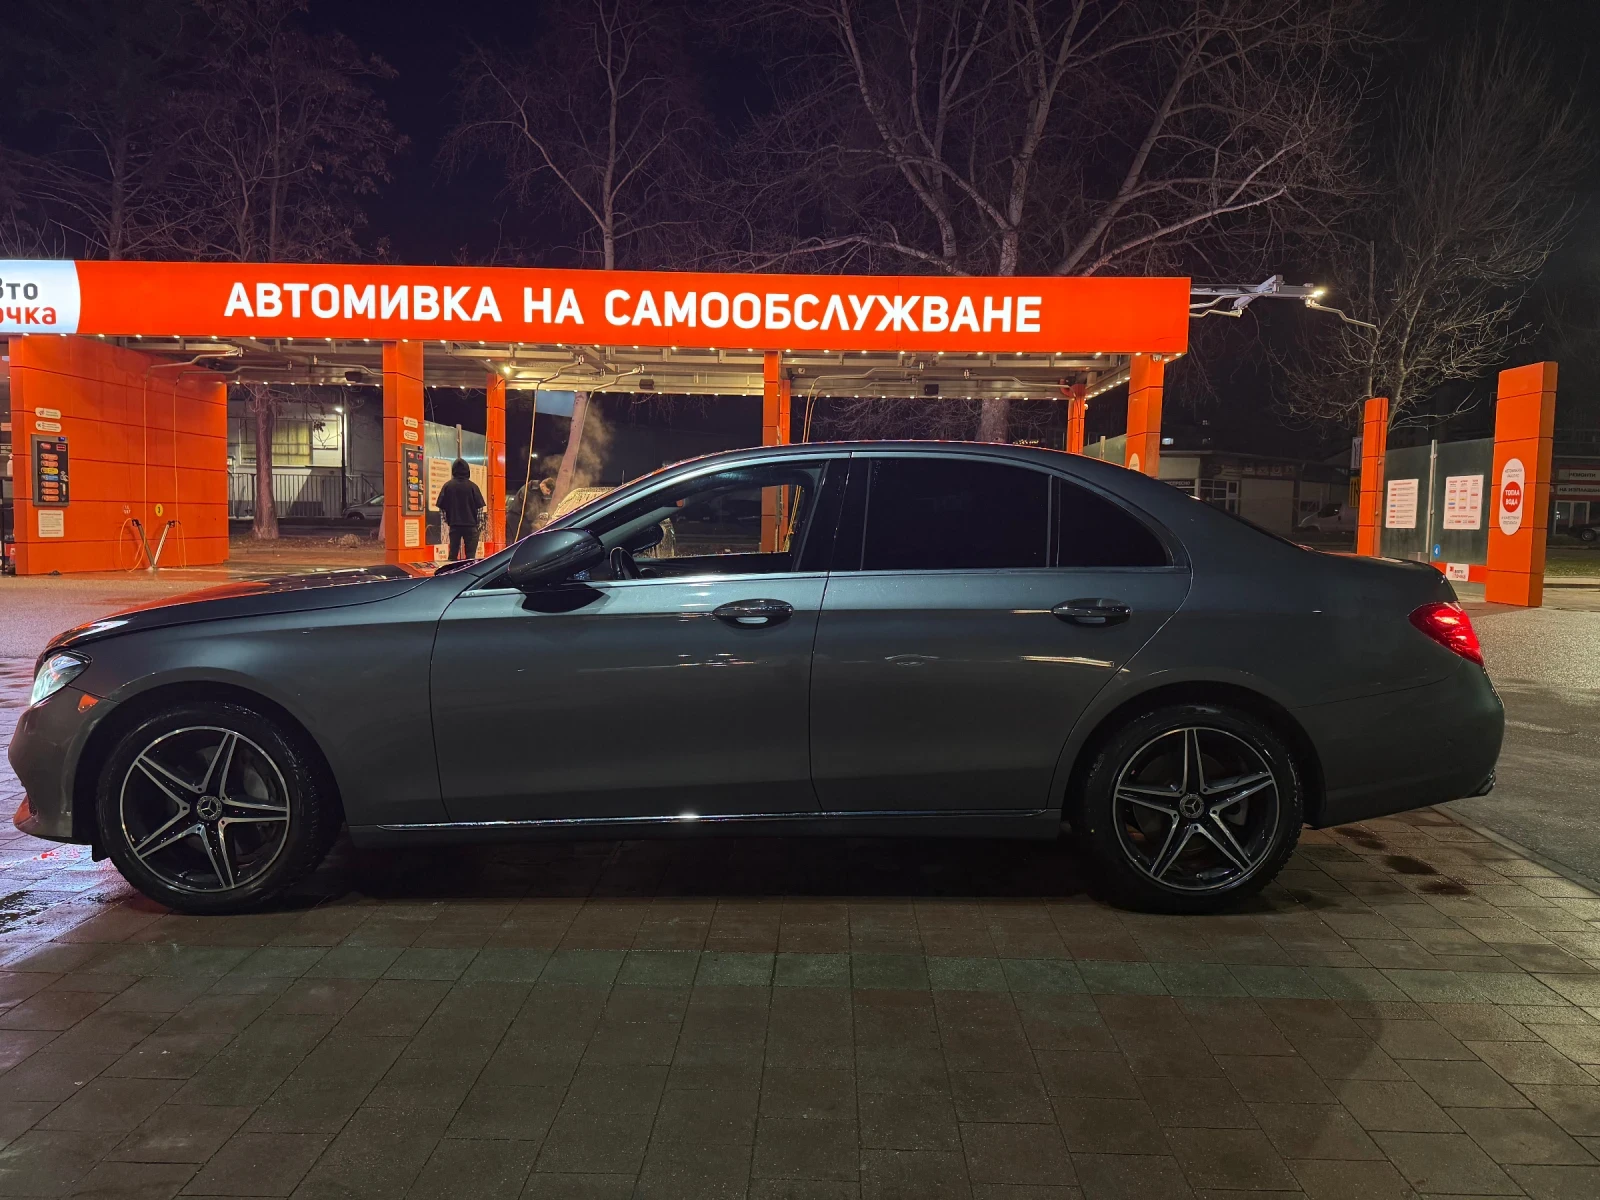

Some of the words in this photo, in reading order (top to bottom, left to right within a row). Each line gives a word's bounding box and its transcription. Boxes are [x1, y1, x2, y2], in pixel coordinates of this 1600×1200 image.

[0, 278, 38, 300] то
[0, 306, 57, 325] чка
[224, 281, 503, 322] АВТОМИВКА
[523, 287, 585, 325] НА
[604, 289, 1042, 333] САМООБСЛУЖВАНЕ
[1505, 489, 1520, 497] ТОПЛА
[1505, 498, 1518, 506] ВОДА
